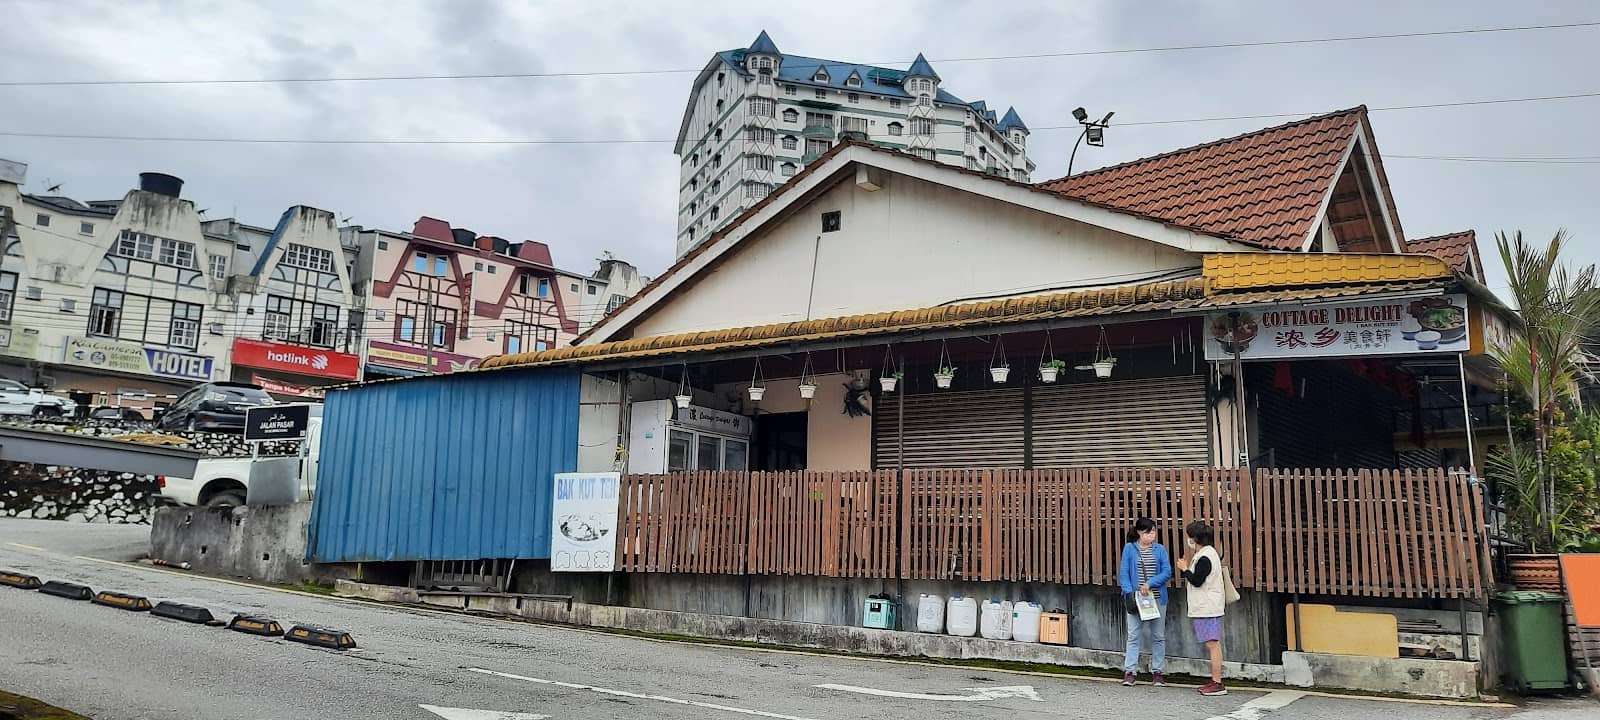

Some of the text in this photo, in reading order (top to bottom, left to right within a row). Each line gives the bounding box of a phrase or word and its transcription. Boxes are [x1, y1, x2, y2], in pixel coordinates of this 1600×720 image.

[1262, 304, 1403, 328] COTTAGE DELIGHT
[152, 351, 209, 378] HOTEL
[267, 350, 309, 366] hotlink
[259, 420, 294, 429] JALAN PASAR
[557, 478, 574, 500] BAK
[578, 478, 596, 499] KUT
